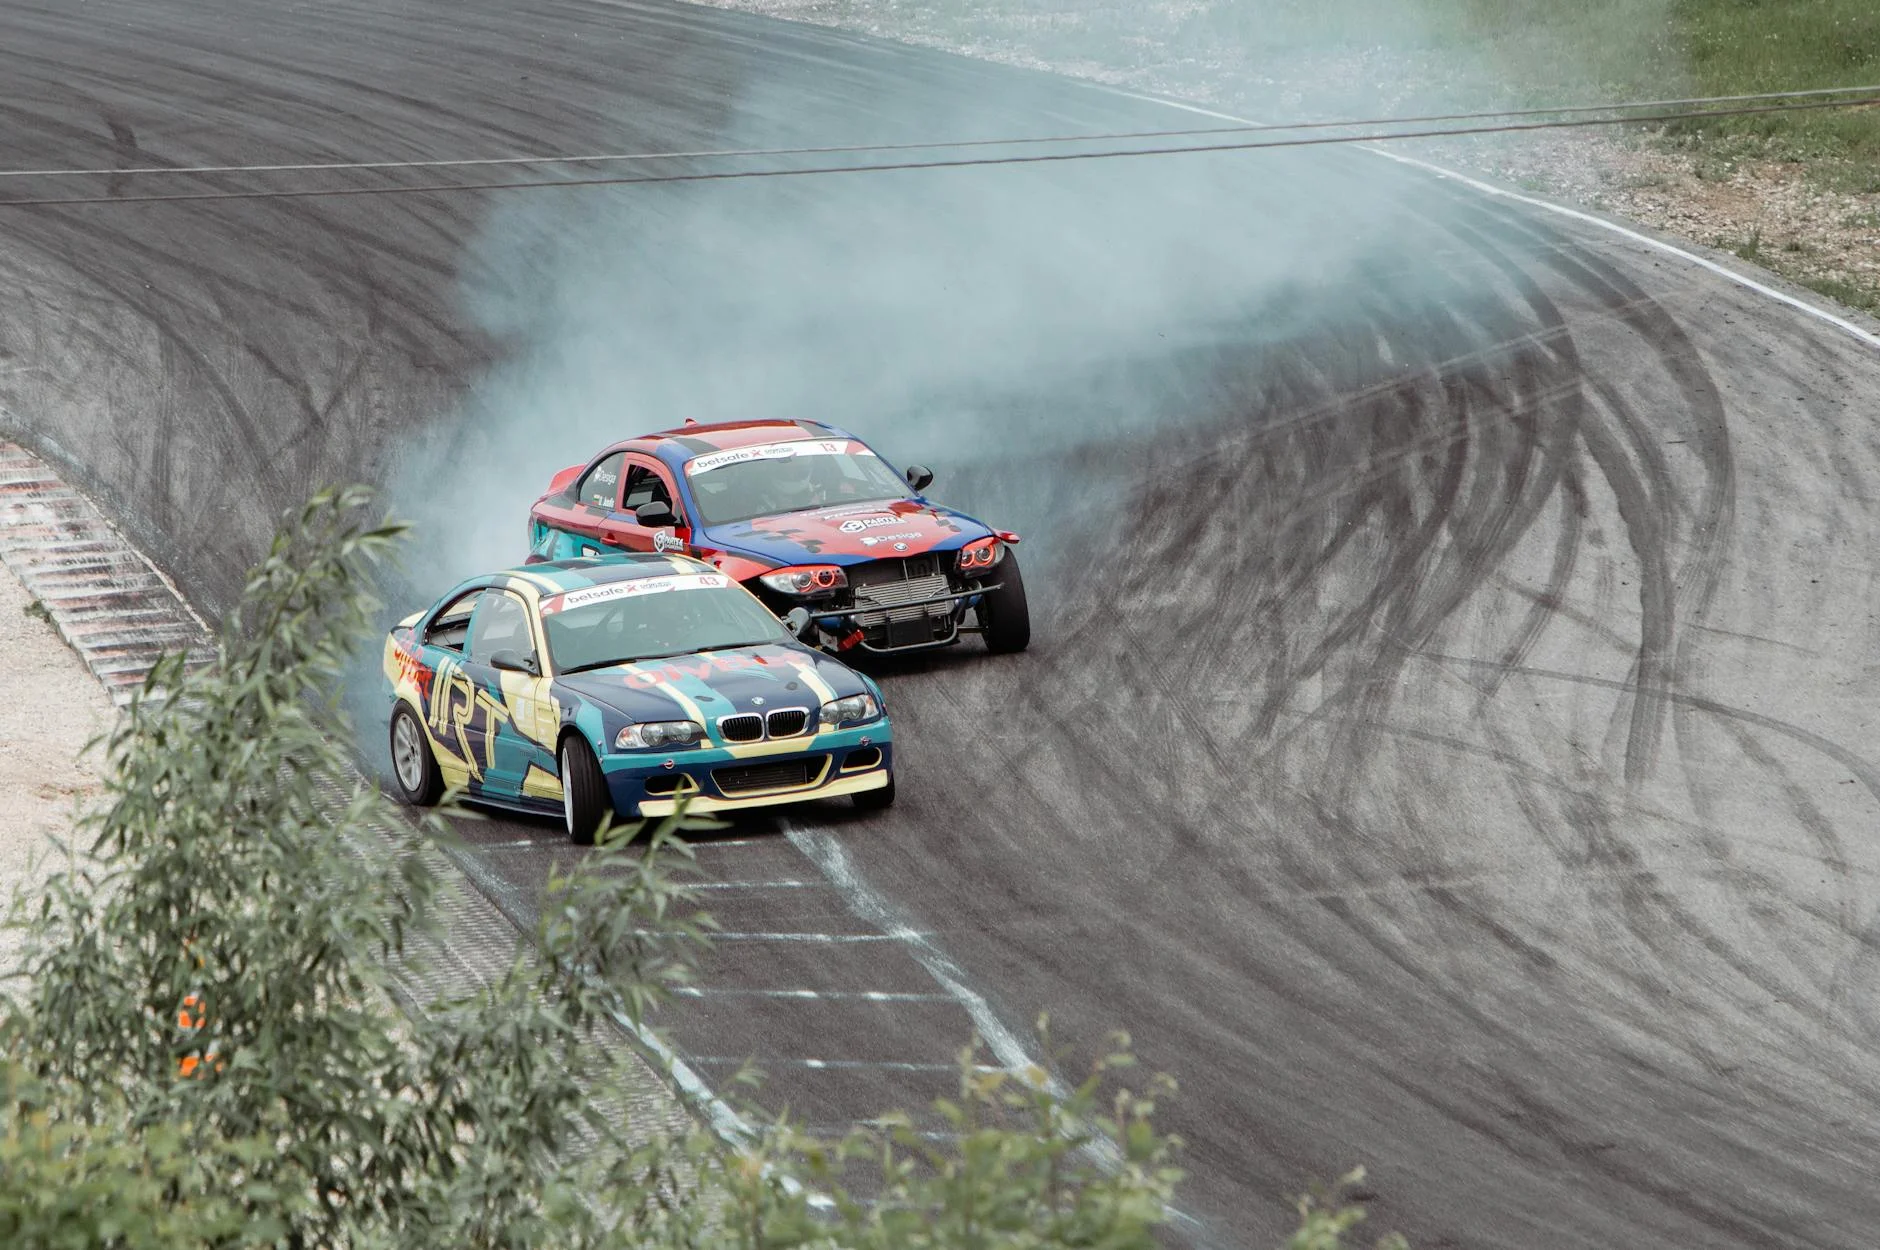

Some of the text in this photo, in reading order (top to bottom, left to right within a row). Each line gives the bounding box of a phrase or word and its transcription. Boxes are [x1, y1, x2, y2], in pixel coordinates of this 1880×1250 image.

[819, 442, 837, 453] 13
[696, 453, 750, 469] betsafe
[698, 576, 720, 586] 43
[567, 588, 625, 605] betsafe
